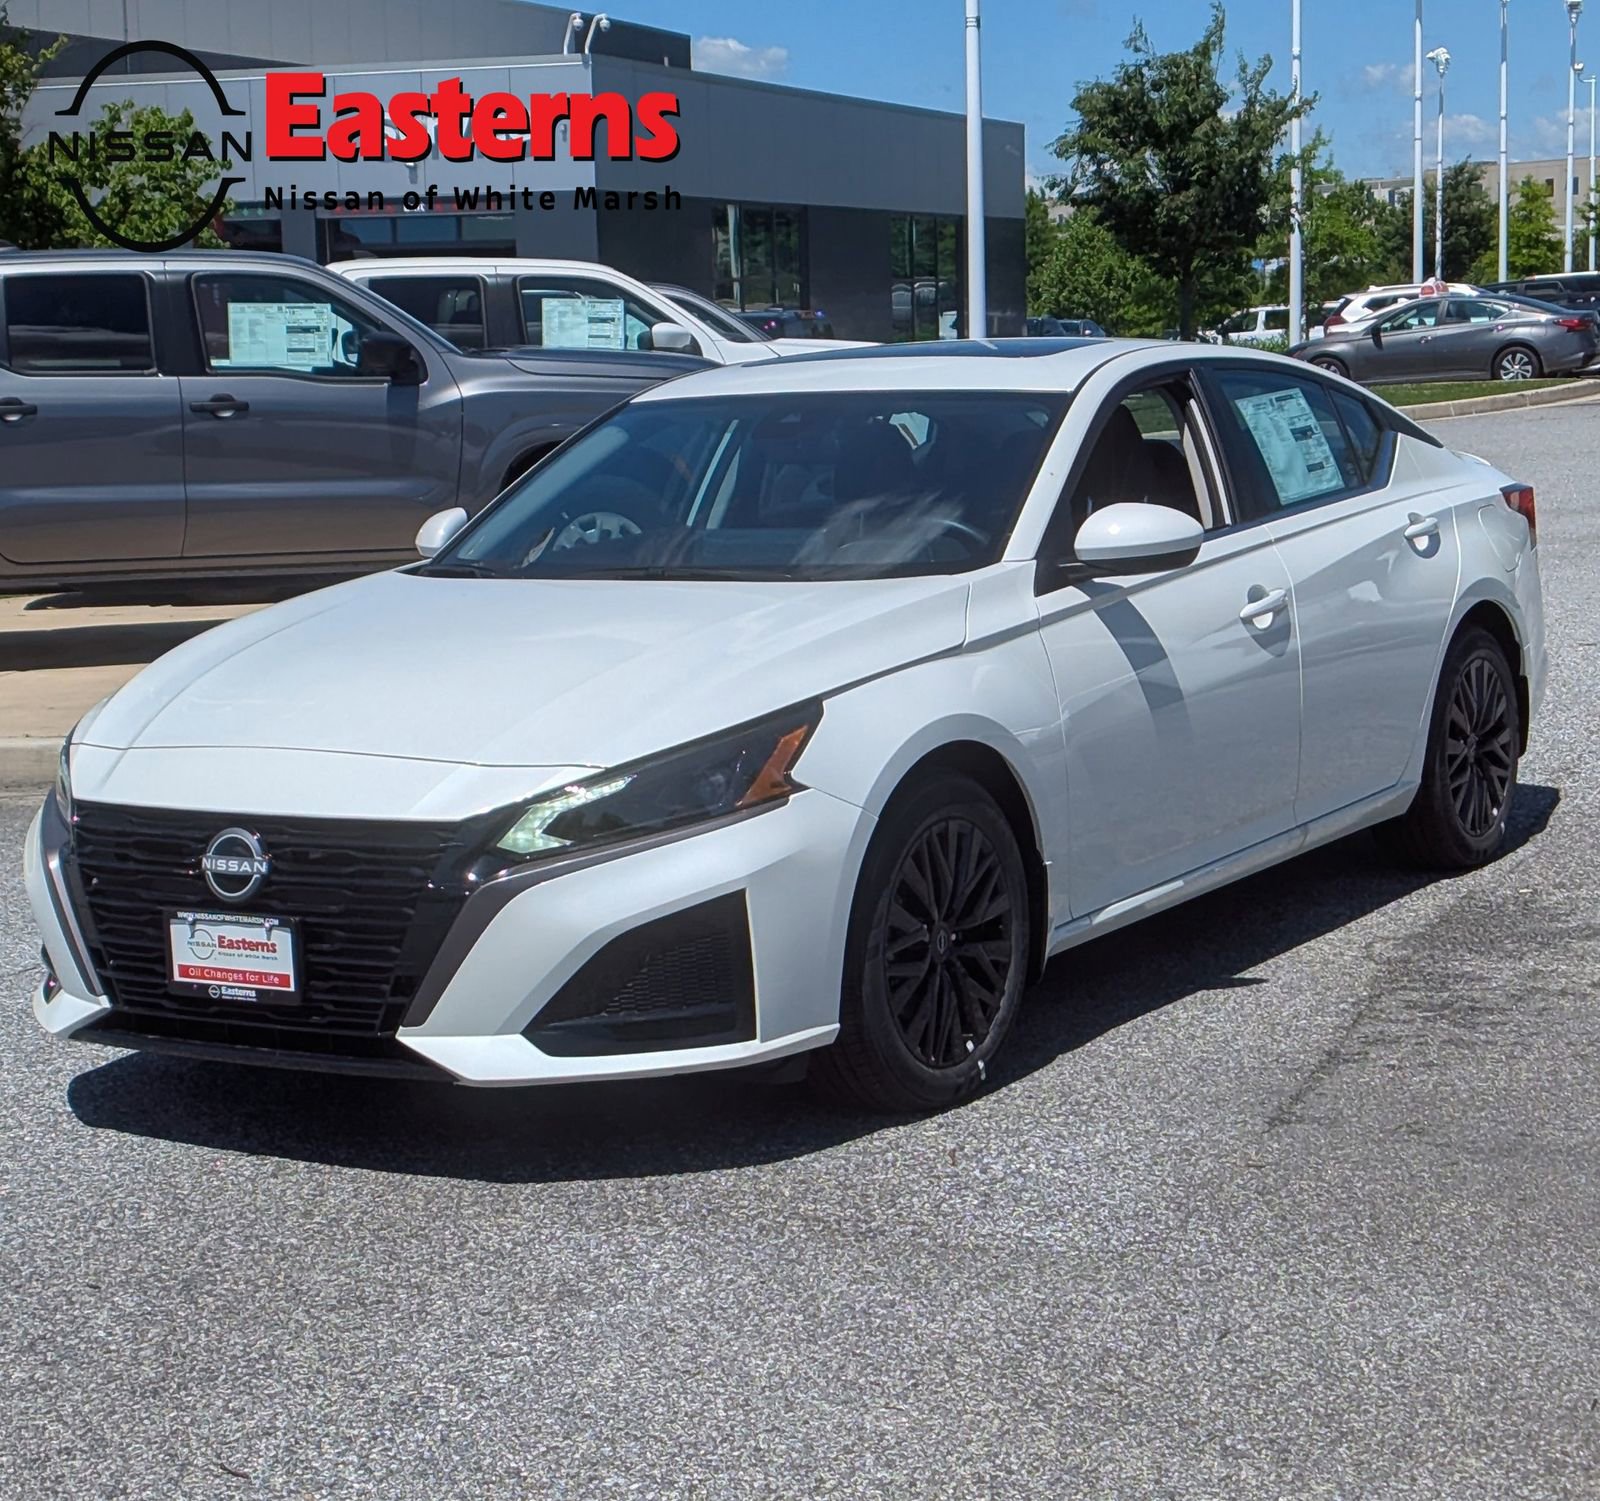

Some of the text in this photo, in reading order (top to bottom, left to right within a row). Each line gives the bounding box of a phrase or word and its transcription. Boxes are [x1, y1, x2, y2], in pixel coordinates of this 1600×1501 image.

[201, 857, 267, 873] NISSAN
[187, 940, 217, 948] NISSAN
[217, 935, 277, 953] Easterns
[188, 967, 280, 984] Oil Changes for Life
